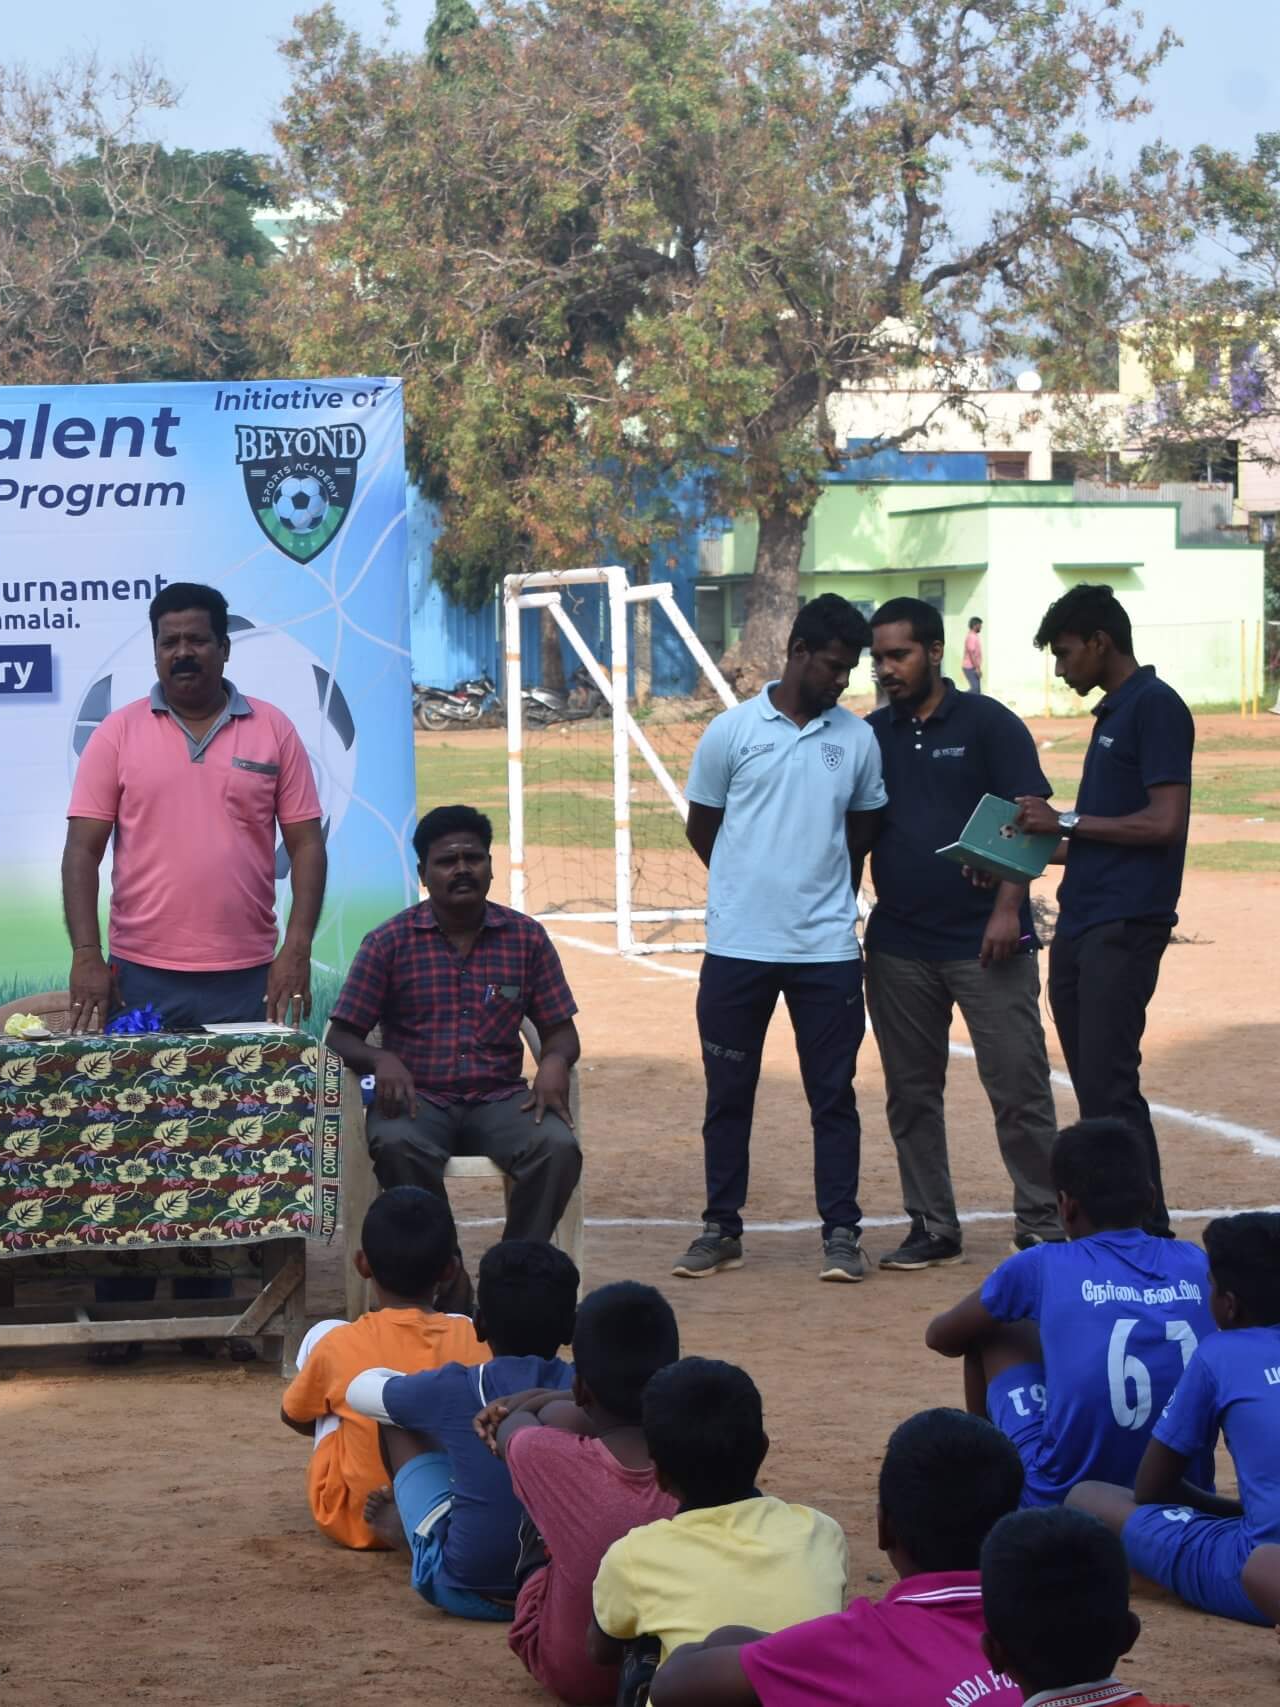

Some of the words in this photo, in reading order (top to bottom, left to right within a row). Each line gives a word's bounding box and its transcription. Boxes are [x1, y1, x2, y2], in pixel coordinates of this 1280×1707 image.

[214, 386, 343, 411] Initiative
[351, 386, 384, 408] of
[236, 424, 364, 463] BEYOND
[261, 465, 291, 503] SPORTS
[295, 462, 339, 498] ACADEMY
[323, 1119, 337, 1174] COMPORT
[321, 1188, 336, 1236] OMPORT
